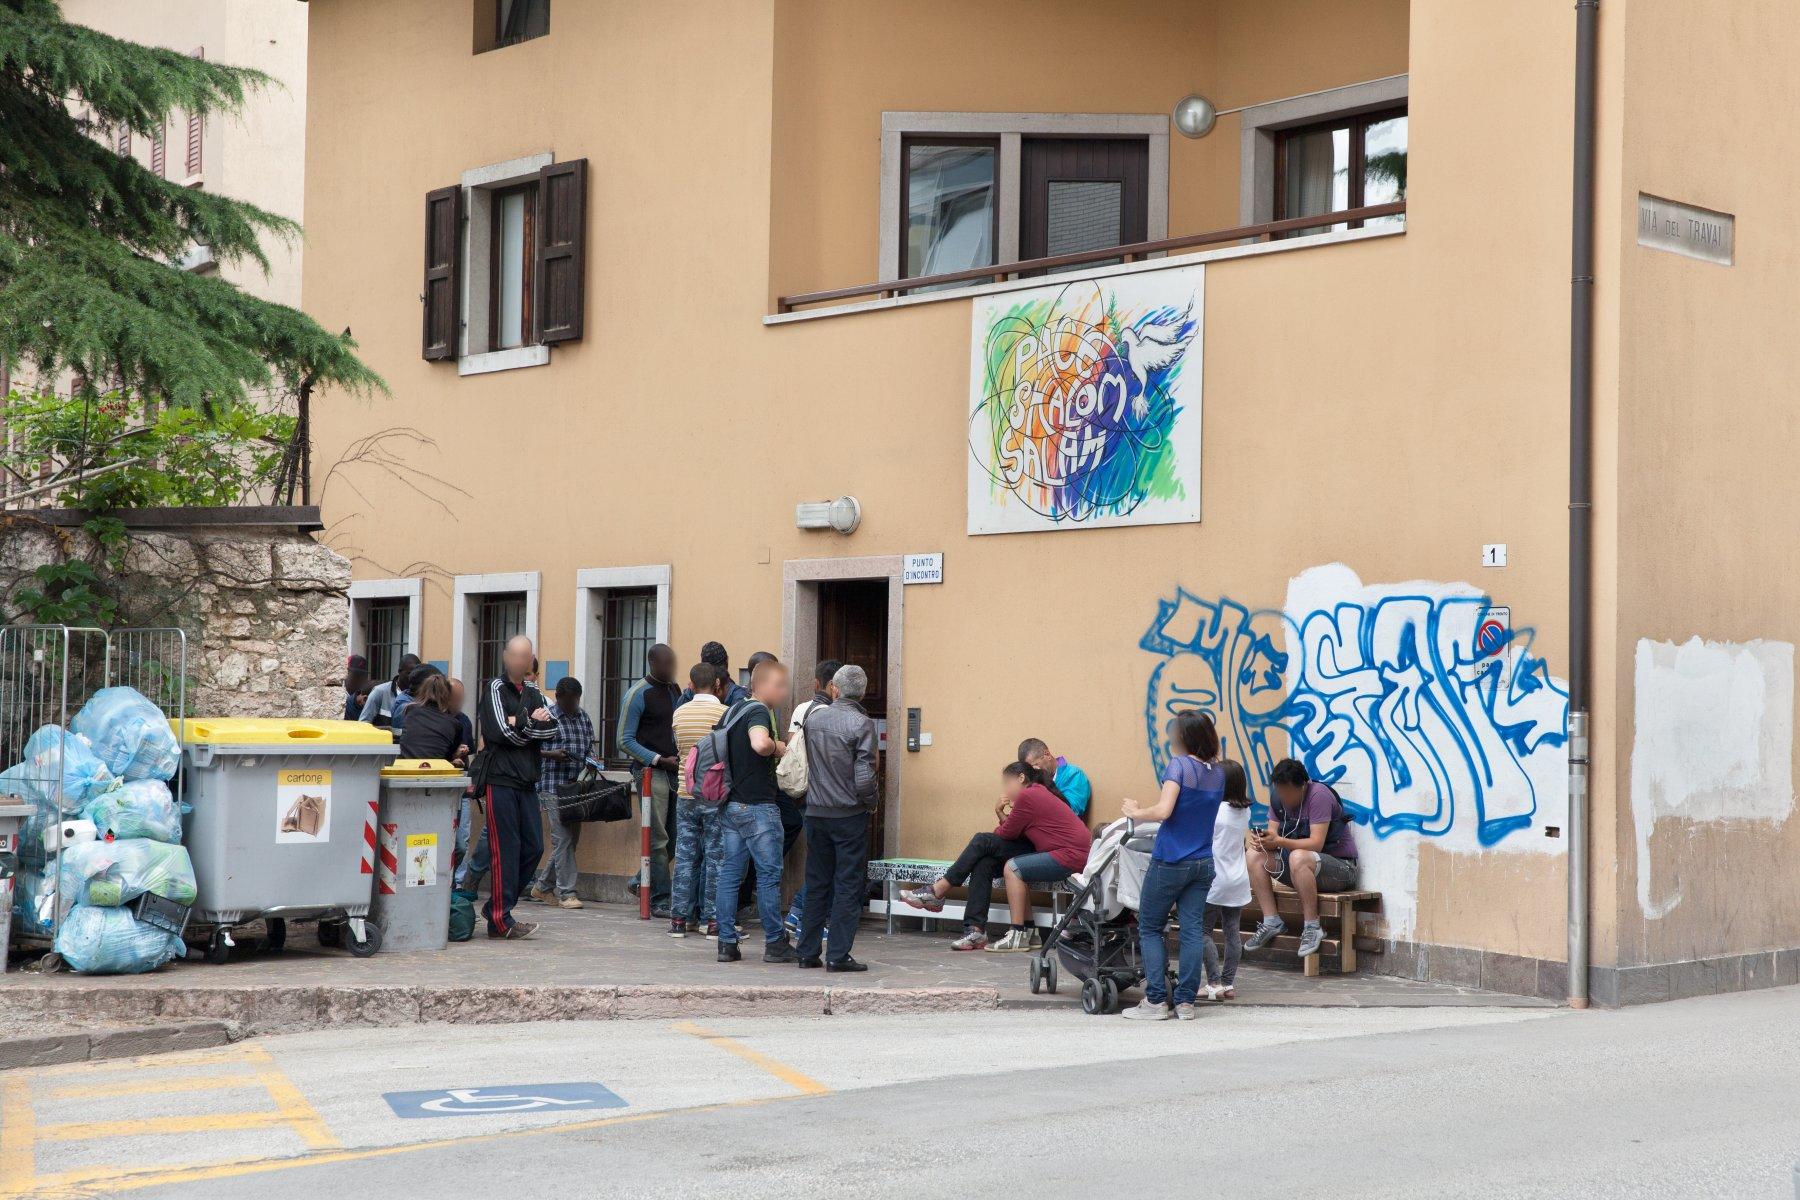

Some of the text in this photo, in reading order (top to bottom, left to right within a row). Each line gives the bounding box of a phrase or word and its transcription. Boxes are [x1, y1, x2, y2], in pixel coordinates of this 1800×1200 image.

[1641, 207, 1722, 247] VIA DEL TRAVAI
[1009, 372, 1128, 437] SHALOM
[1490, 547, 1496, 564] 1
[912, 558, 934, 567] PUNTO
[905, 570, 940, 580] D'INCONTRO
[286, 772, 323, 783] cartone
[413, 838, 430, 846] carta
